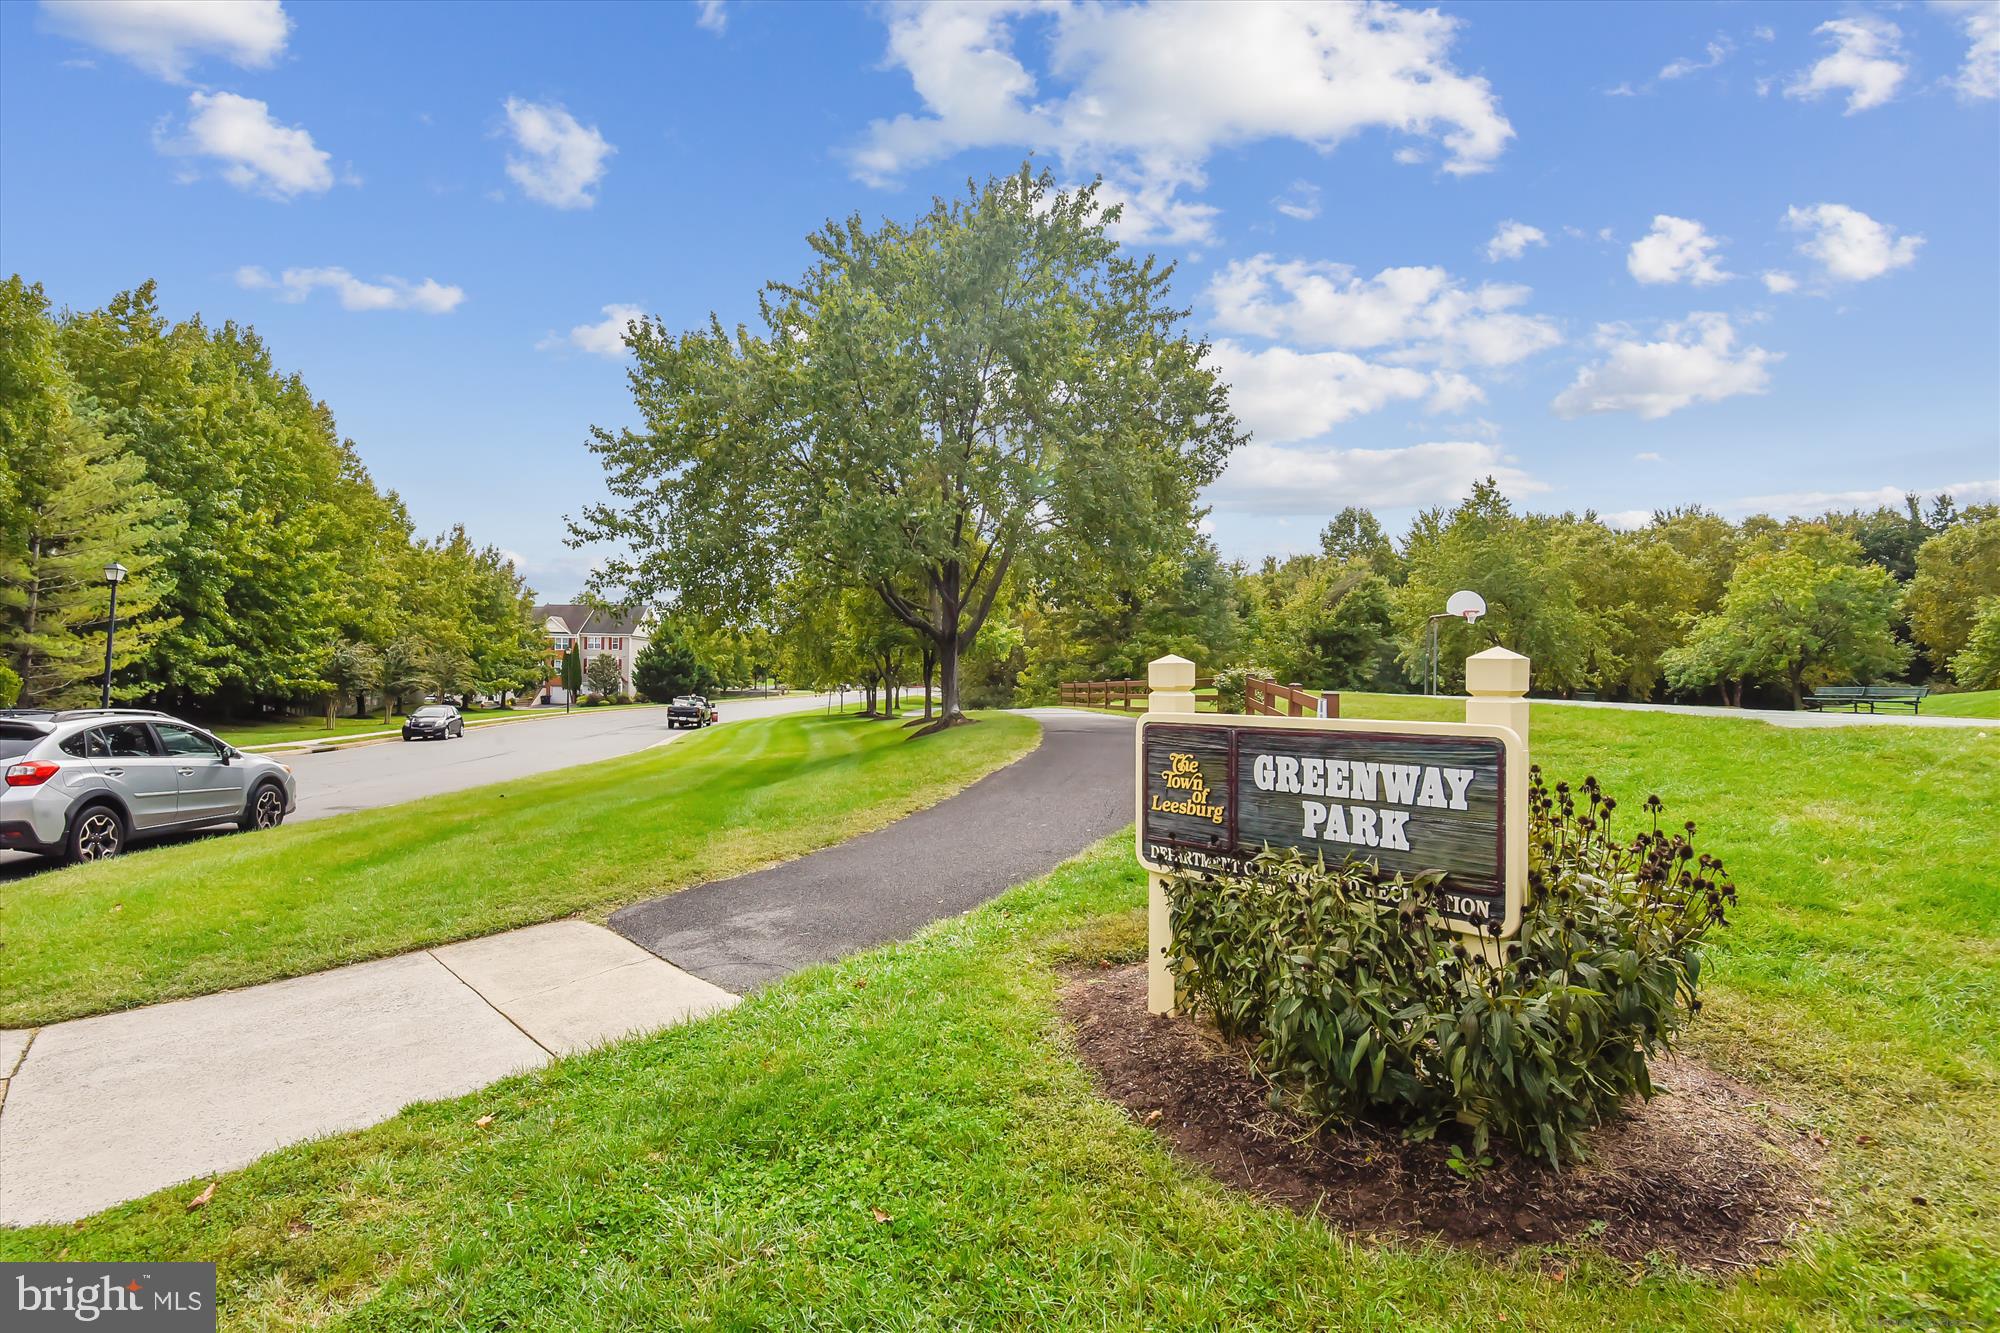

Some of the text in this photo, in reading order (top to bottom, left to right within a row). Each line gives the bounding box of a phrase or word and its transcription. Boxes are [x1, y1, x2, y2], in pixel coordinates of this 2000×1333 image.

[1169, 752, 1199, 775] The
[1161, 770, 1203, 791] Town
[1253, 754, 1474, 811] GREENWAY
[1151, 794, 1225, 824] Leesburg
[1192, 788, 1210, 804] of
[1302, 800, 1410, 851] PARK
